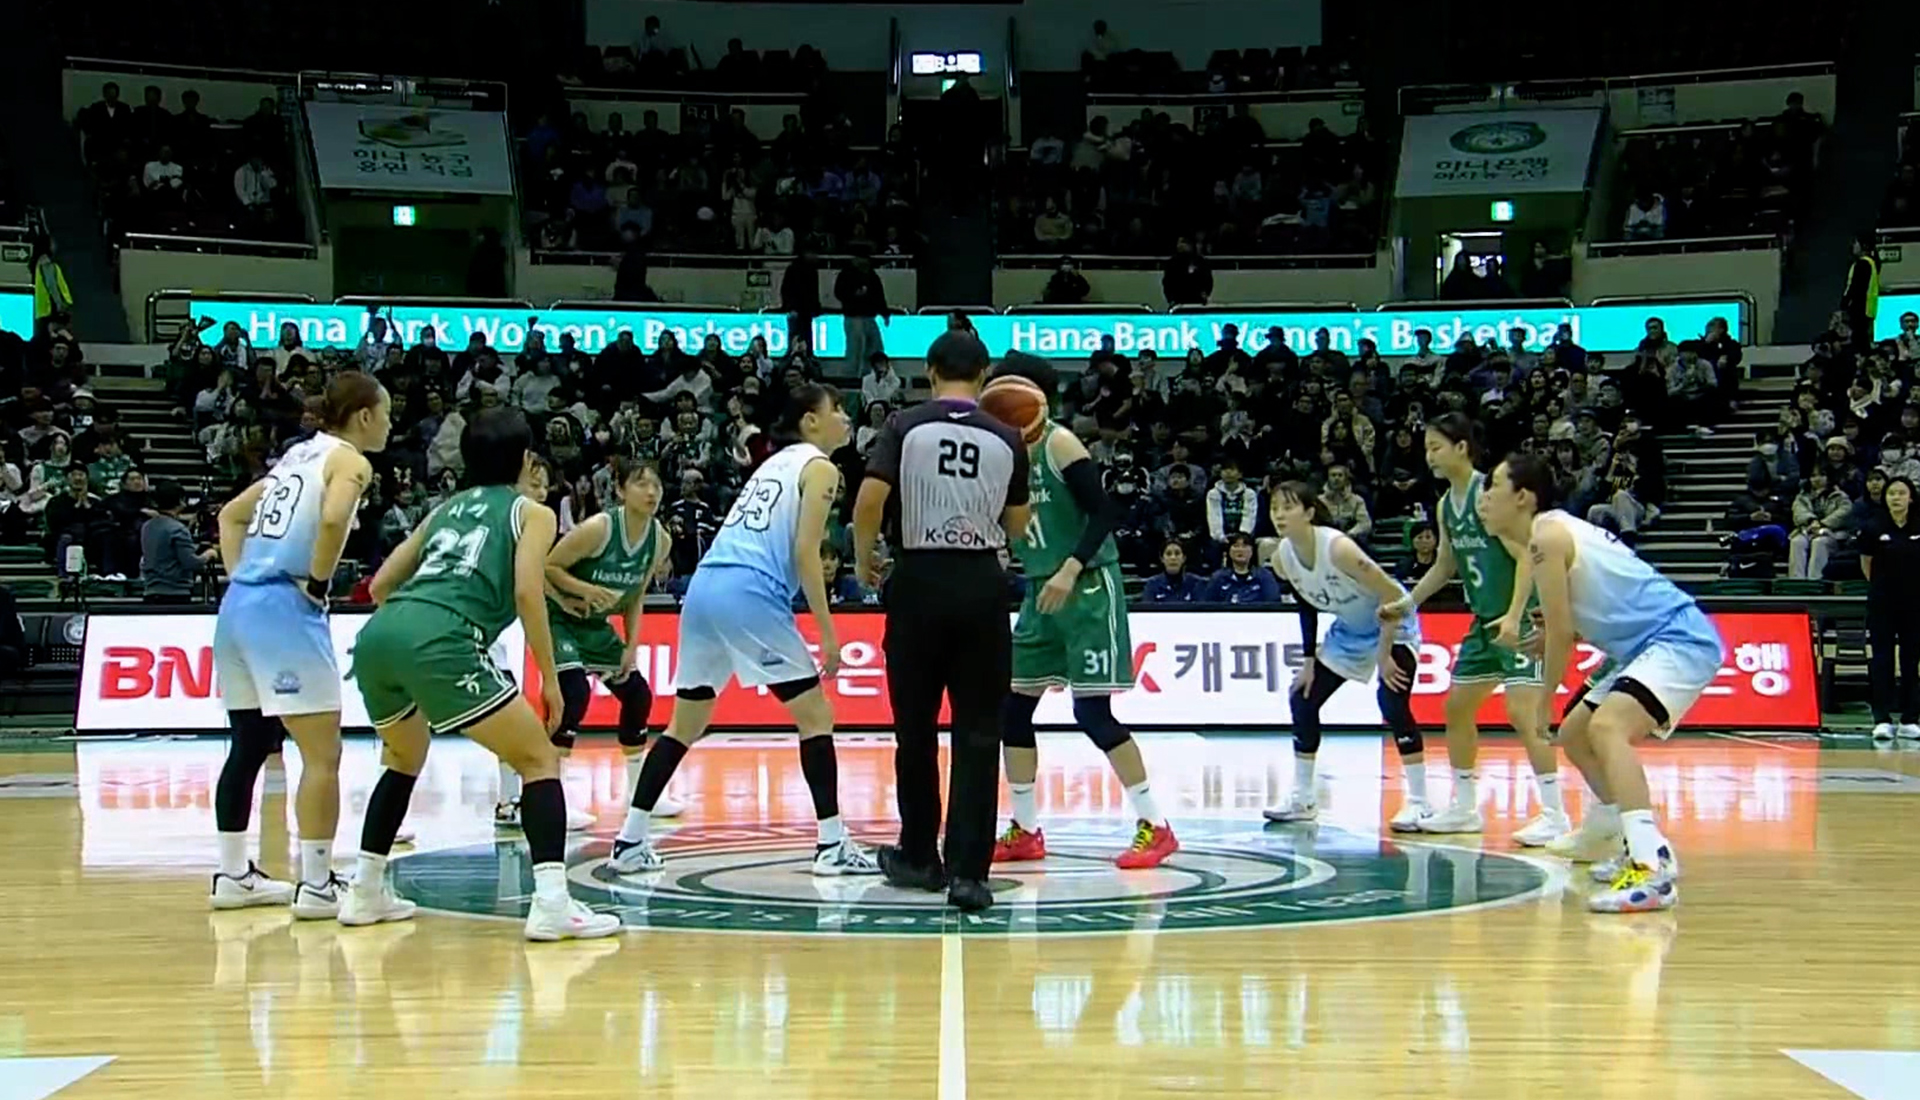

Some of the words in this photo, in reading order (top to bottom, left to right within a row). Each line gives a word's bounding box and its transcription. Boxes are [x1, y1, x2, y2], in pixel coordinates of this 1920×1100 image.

[250, 311, 347, 342] Hna
[1012, 321, 1103, 351] Hana
[1114, 321, 1200, 351] Bank
[938, 439, 980, 479] 29
[415, 524, 490, 578] 21
[1465, 555, 1484, 588] 5
[100, 645, 224, 699] BN
[1083, 649, 1109, 676] 31
